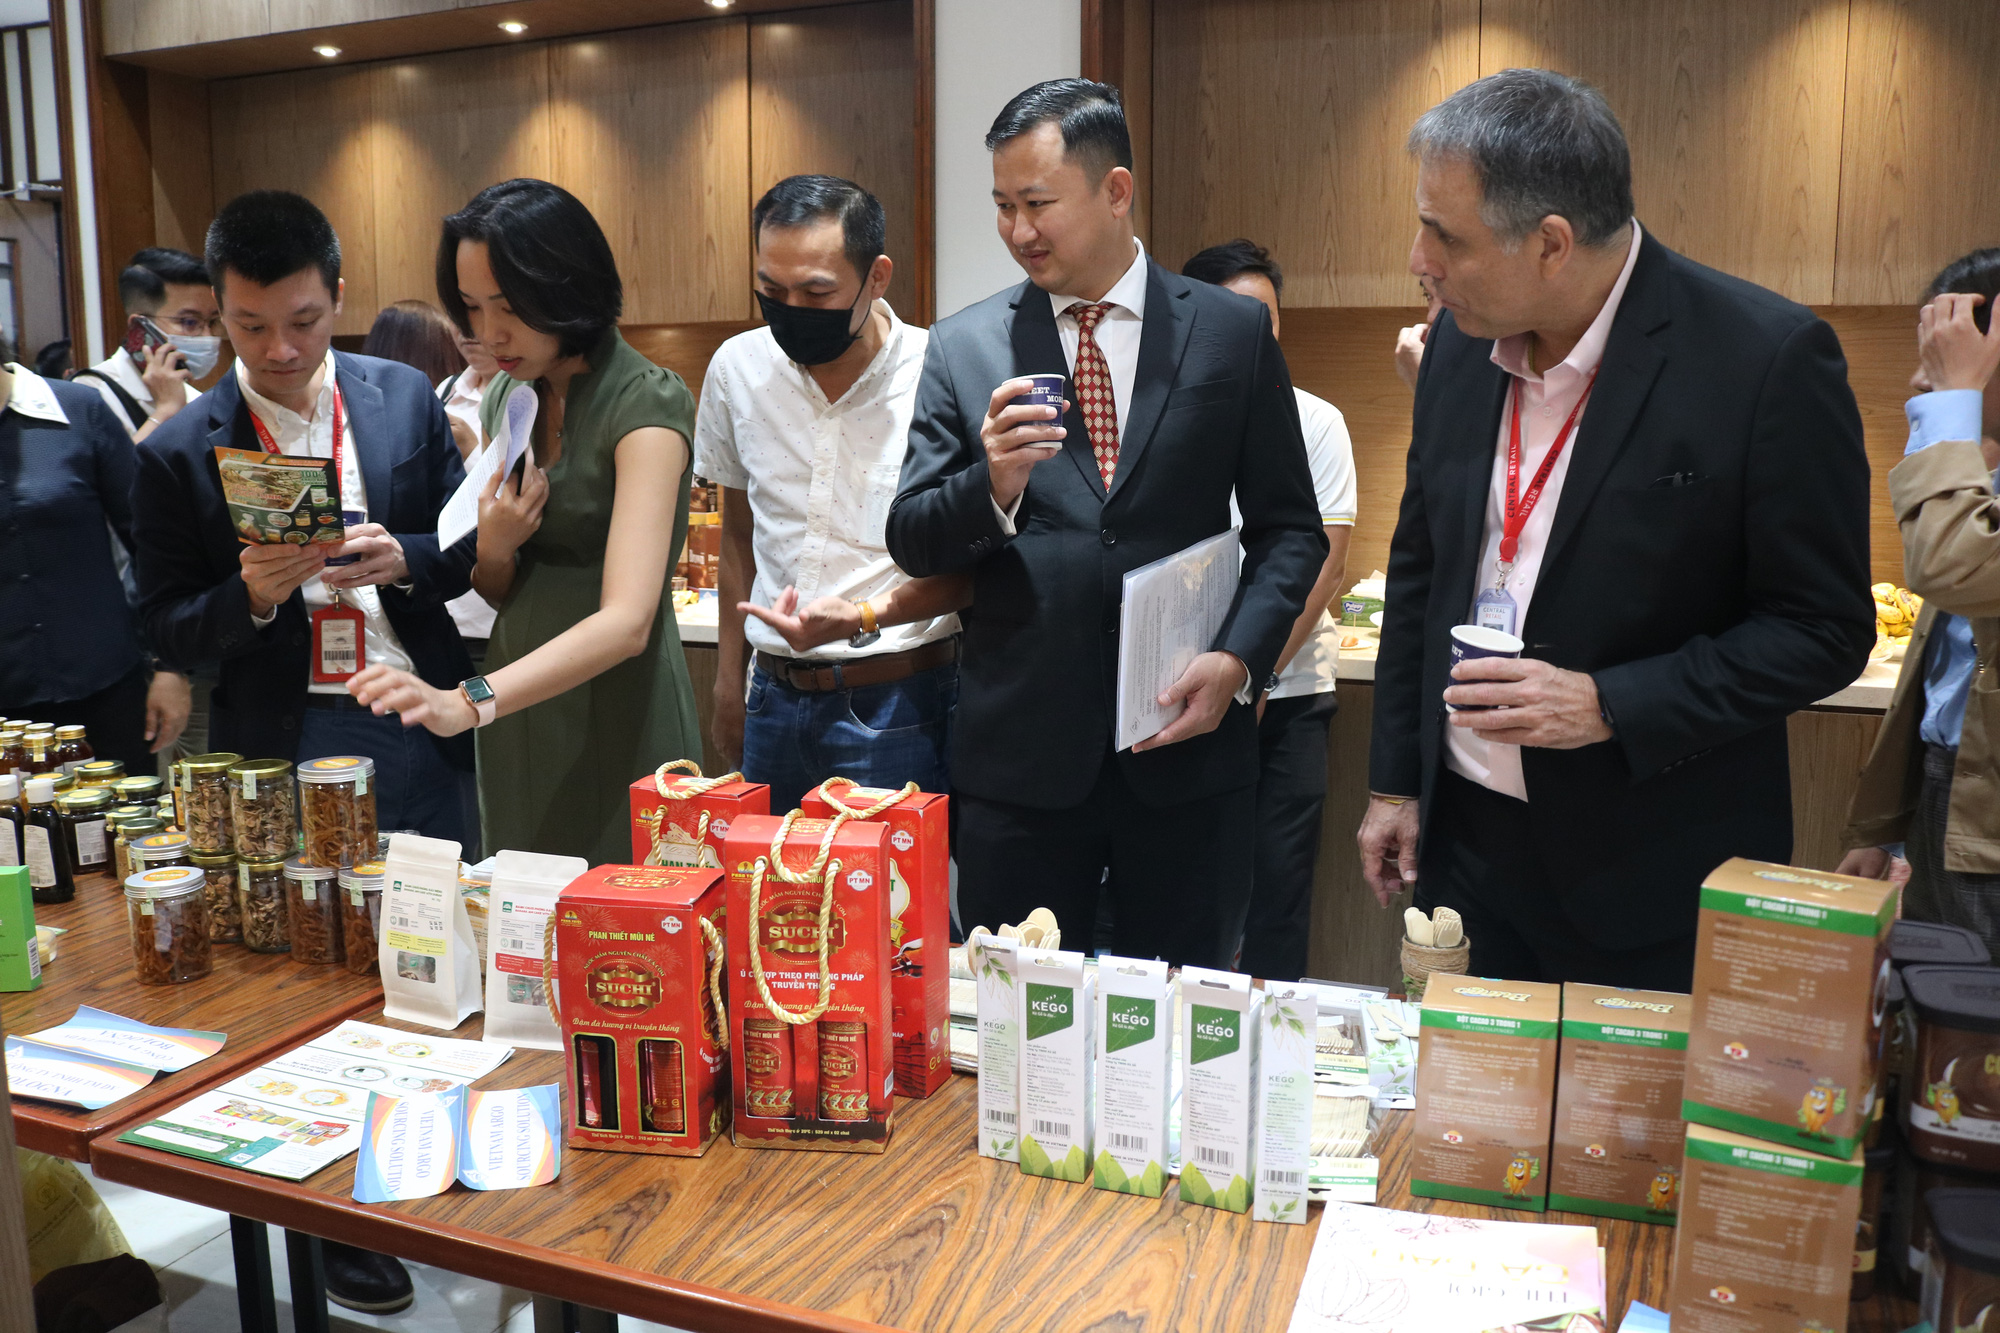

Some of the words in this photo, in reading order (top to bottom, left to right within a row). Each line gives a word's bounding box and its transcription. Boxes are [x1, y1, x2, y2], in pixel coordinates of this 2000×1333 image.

[1534, 450, 1558, 490] CENTRAL
[1507, 476, 1516, 518] CENTRAL
[1519, 488, 1539, 516] RETAIL
[589, 931, 607, 940] PHAN
[609, 930, 628, 941] THIẾT
[630, 932, 644, 941] MŨI
[645, 932, 655, 942] NÉ
[841, 972, 864, 981] PHÁP
[596, 983, 653, 996] SUCHI
[1032, 1001, 1067, 1013] KEGO
[1593, 998, 1674, 1013] Bungo
[984, 1022, 1006, 1030] KEGO
[1112, 1012, 1149, 1026] KEGO
[1456, 1015, 1468, 1023] BỘT
[1470, 1017, 1489, 1025] CACAO
[1496, 1019, 1516, 1028] TRONG
[1197, 1024, 1234, 1038] KEGO
[1601, 1026, 1614, 1034] BỘT
[1615, 1027, 1635, 1037] CACAO
[1643, 1030, 1662, 1039] TRONG
[1269, 1075, 1294, 1084] KEGO
[490, 1105, 504, 1127] ARGO
[517, 1093, 530, 1133] SOLUTION
[391, 1102, 409, 1145] SOURCING
[418, 1110, 434, 1150] VIETNAM
[489, 1130, 504, 1170] VIETNAM
[517, 1134, 531, 1180] SOURCING
[386, 1146, 405, 1194] SOLUTION
[416, 1152, 431, 1178] ARGO
